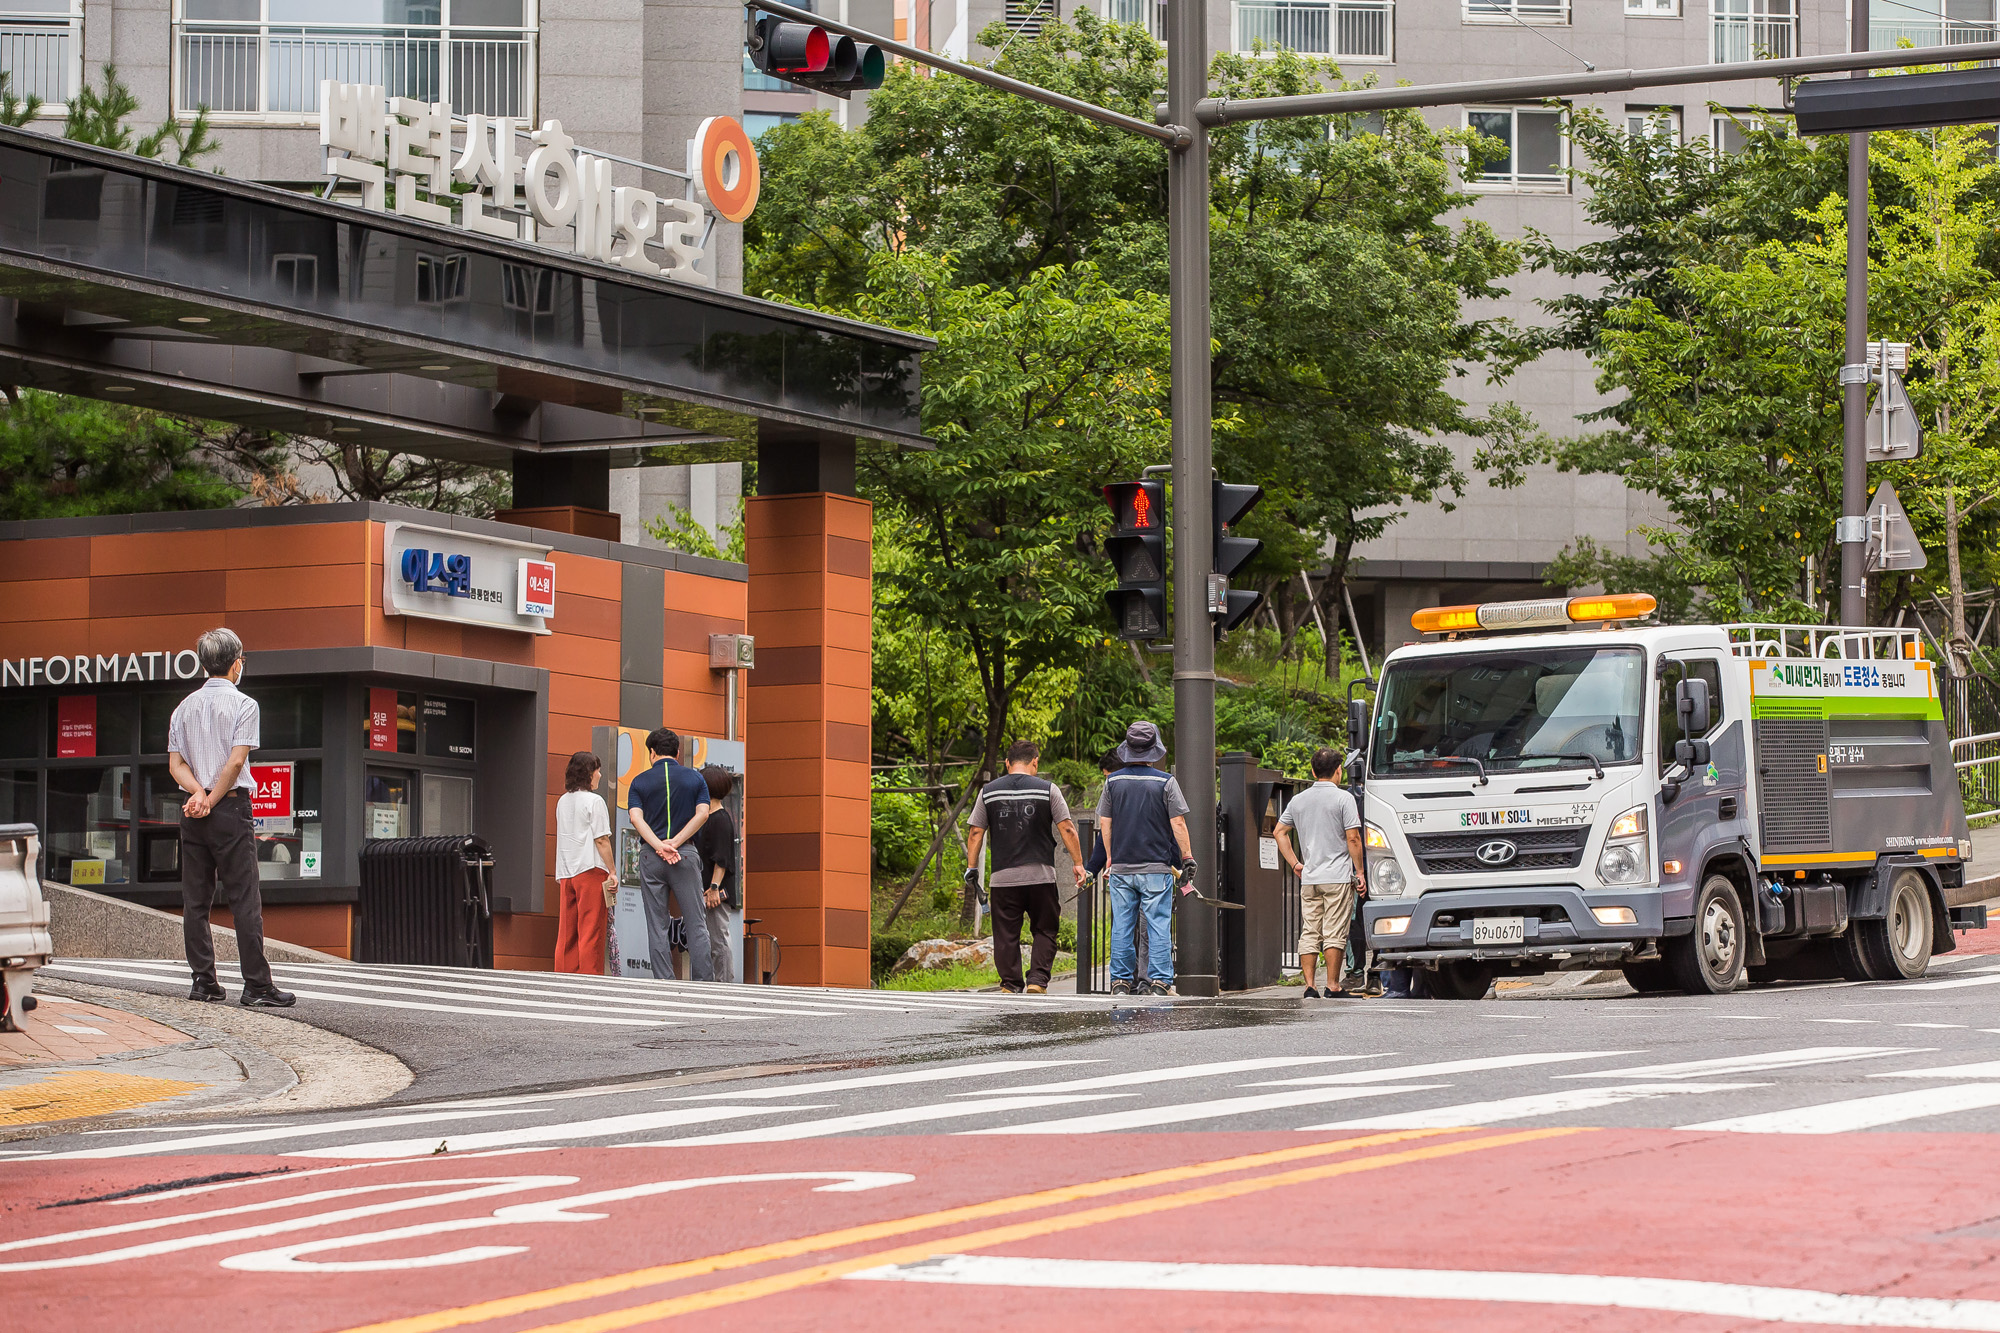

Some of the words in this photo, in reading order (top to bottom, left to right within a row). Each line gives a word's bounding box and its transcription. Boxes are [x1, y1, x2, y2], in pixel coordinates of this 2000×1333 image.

[402, 548, 470, 598] 에스원
[529, 576, 549, 593] 에스원
[526, 604, 544, 614] SECOM
[2, 649, 209, 687] NFORMATIO
[1785, 665, 1822, 687] 미세먼지
[1823, 672, 1841, 687] 줄이기
[1844, 666, 1880, 688] 도로청소
[1882, 673, 1905, 688] 중입니다
[373, 712, 387, 726] 정문
[1829, 746, 1846, 762] 은평구
[1848, 746, 1864, 762] 살수4
[1571, 804, 1595, 815] 살수4
[1402, 812, 1426, 824] 은평구
[1536, 816, 1577, 826] MIGHTY
[1886, 836, 1914, 848] SHINJEONG
[1474, 925, 1522, 940] 89나0670
